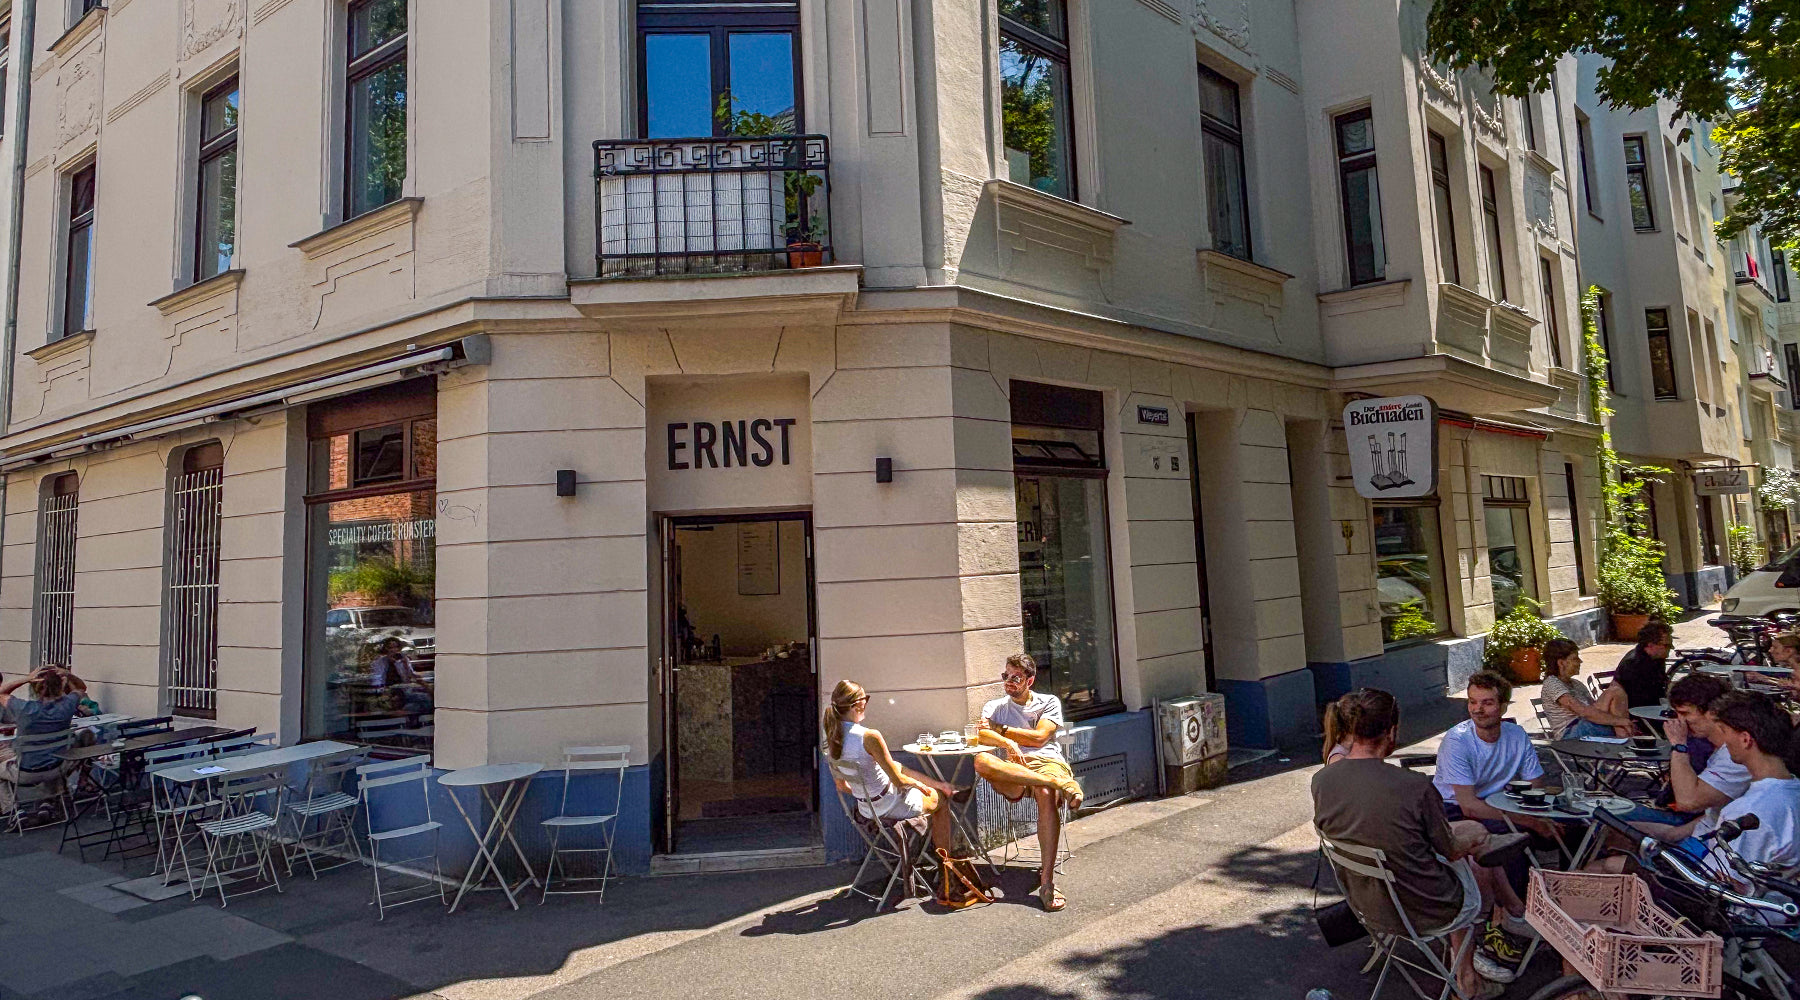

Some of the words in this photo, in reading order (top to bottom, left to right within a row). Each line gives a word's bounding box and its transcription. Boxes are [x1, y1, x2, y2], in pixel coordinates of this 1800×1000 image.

[1350, 407, 1424, 426] Buchladen
[1364, 405, 1376, 413] Der
[1379, 403, 1402, 412] andere
[667, 418, 797, 471] ERNST
[328, 525, 365, 546] SPECIALTY
[367, 522, 397, 543] COFFEE
